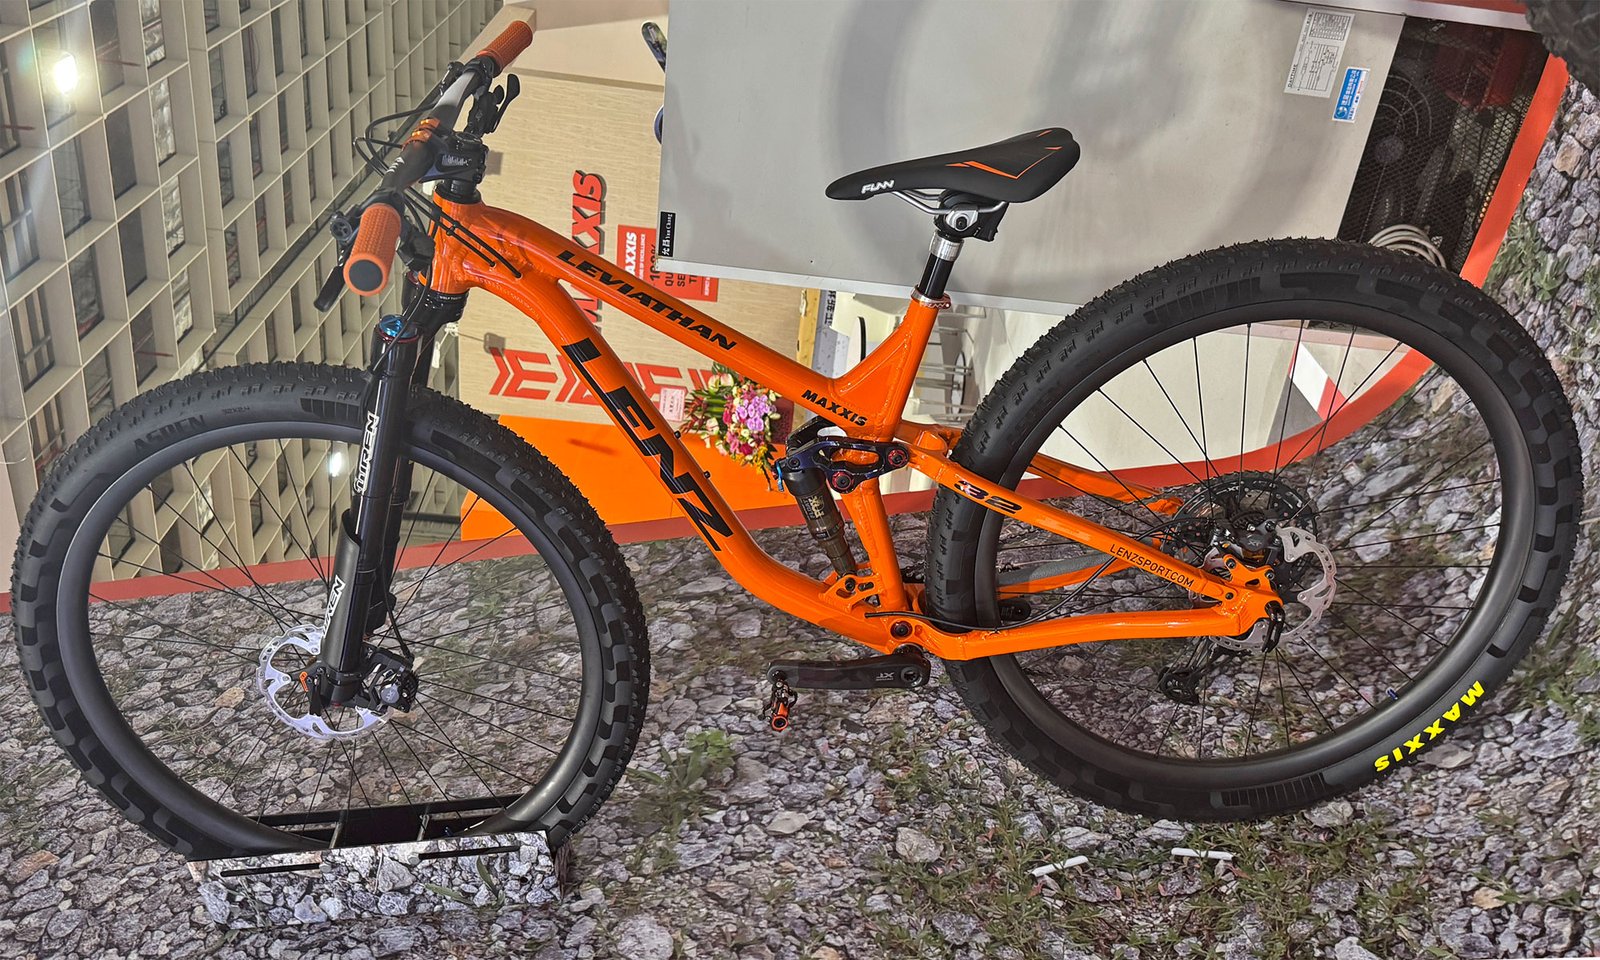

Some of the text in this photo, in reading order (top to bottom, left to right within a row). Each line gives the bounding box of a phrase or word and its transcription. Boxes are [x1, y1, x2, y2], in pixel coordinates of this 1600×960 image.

[860, 179, 895, 194] FUNN
[624, 231, 638, 276] AXXIS
[556, 249, 738, 351] LEVIATHAN
[801, 388, 868, 427] MAXXIS
[133, 414, 207, 451] ASPEN
[561, 336, 734, 552] LENZ
[953, 480, 1023, 515] 32
[1109, 543, 1195, 588] LENZSPORT.COM
[1374, 680, 1485, 772] MAXXIS
